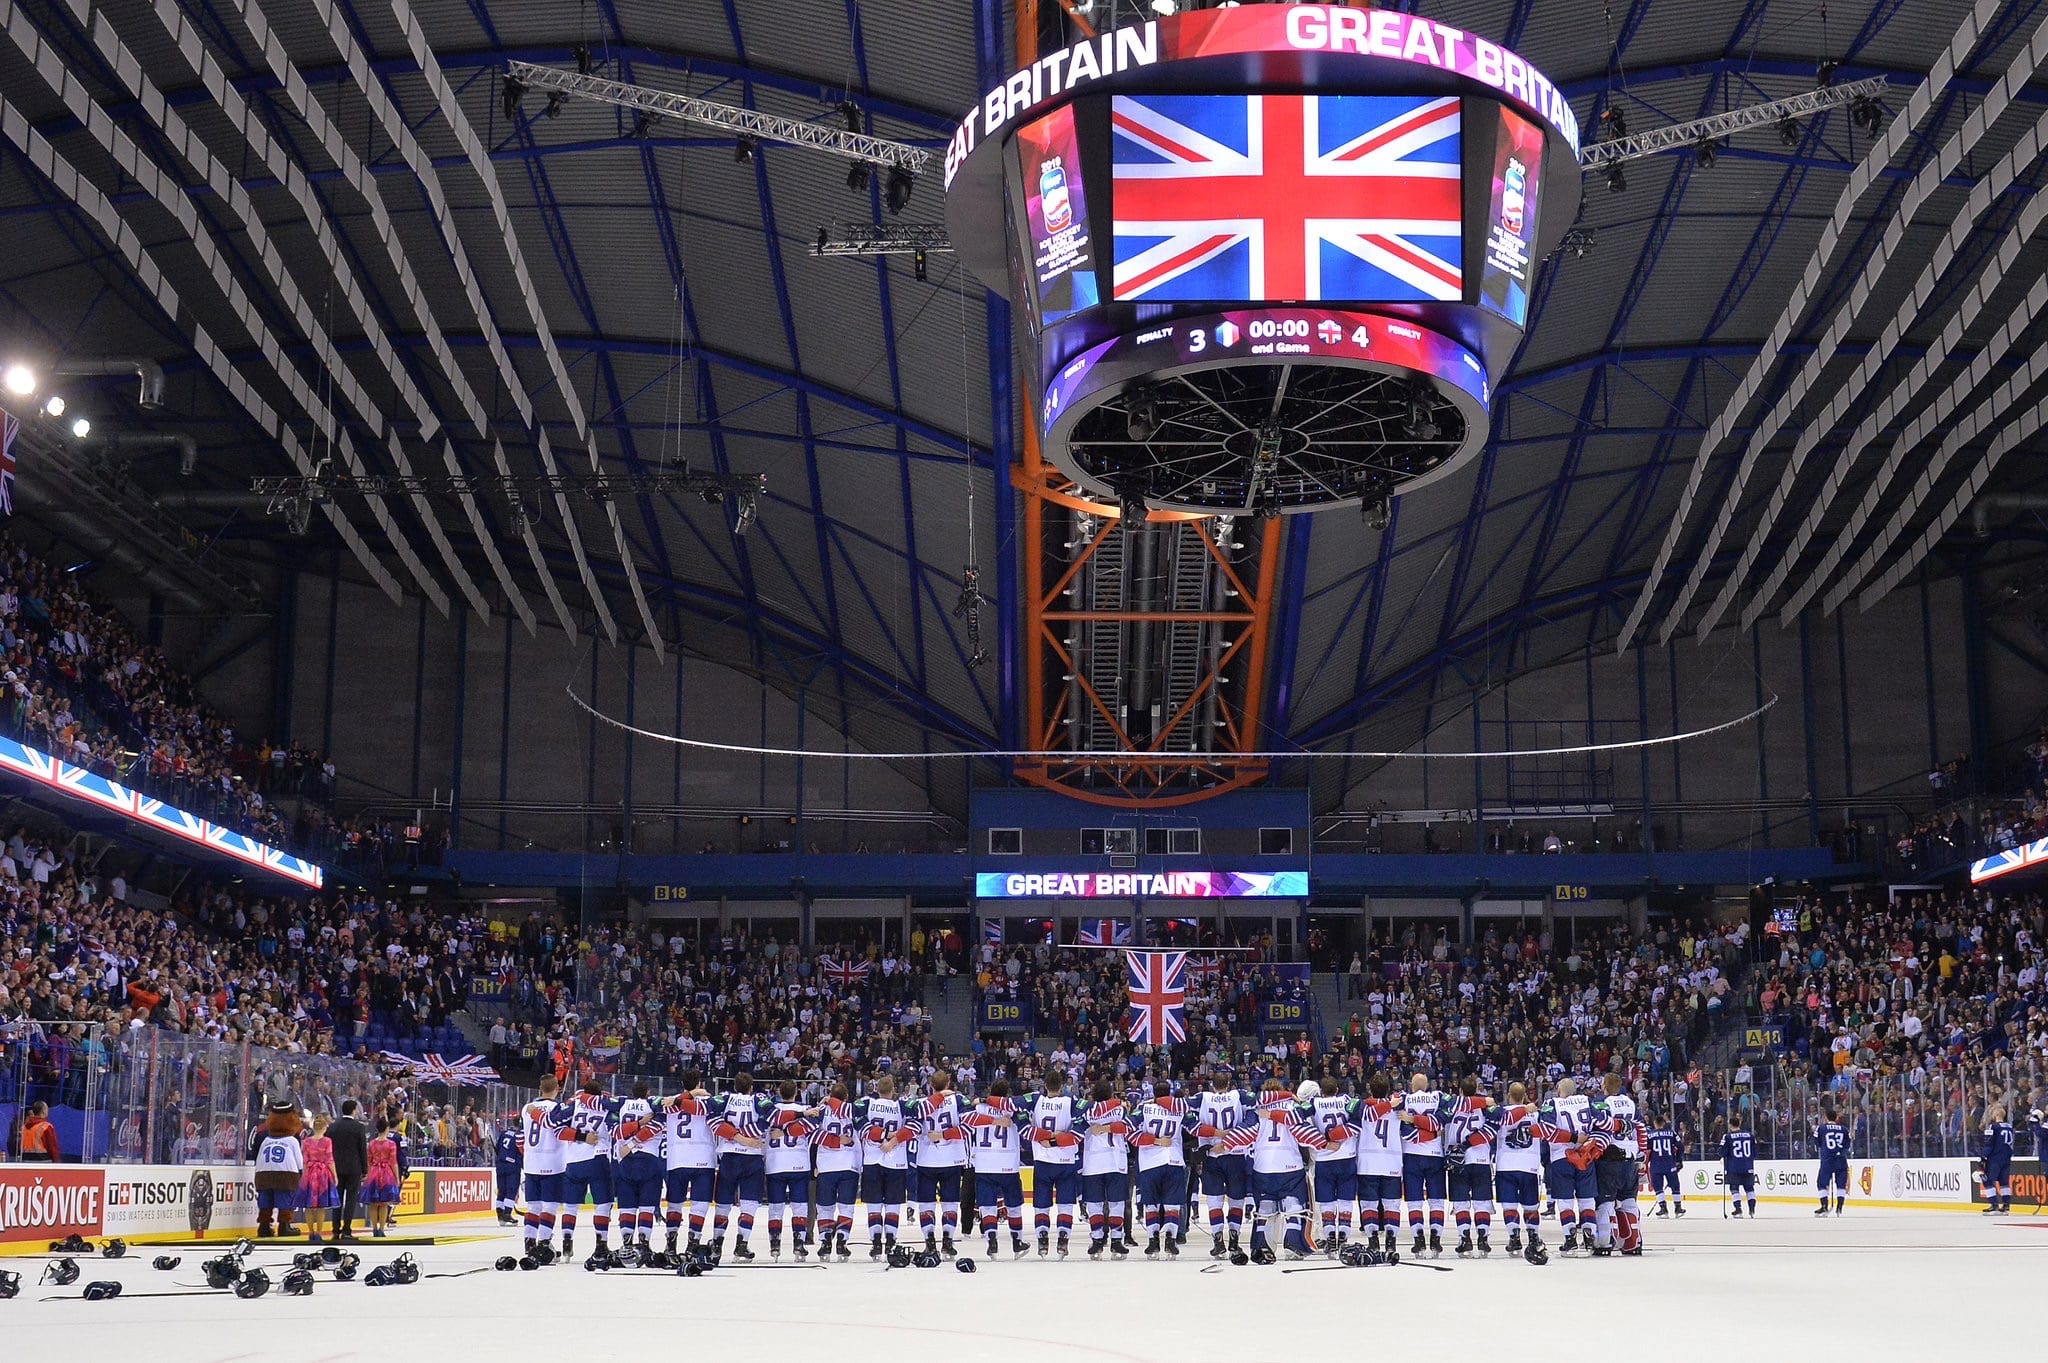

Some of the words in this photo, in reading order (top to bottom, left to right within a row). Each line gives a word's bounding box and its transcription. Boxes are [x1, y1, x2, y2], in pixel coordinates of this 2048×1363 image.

[985, 20, 1157, 136] BRITAIN
[1286, 6, 1463, 71] GREAT
[1476, 38, 1579, 161] BRITAIN
[1136, 327, 1174, 345] PENALTY
[1250, 320, 1309, 338] 00:00
[1352, 326, 1369, 347] 4
[1388, 325, 1421, 340] PENALTY
[1189, 329, 1206, 352] 3
[1276, 342, 1310, 353] Game
[656, 887, 667, 899] B
[672, 887, 687, 898] 18
[1007, 874, 1090, 895] GREAT
[1095, 874, 1197, 895] BRITAIN
[1557, 886, 1569, 899] A
[1573, 886, 1587, 898] 19
[989, 1005, 1001, 1018] B
[1003, 1006, 1019, 1018] 19
[1271, 1005, 1283, 1018] B
[1285, 1006, 1300, 1017] 19
[1748, 1031, 1760, 1046] A
[627, 1103, 644, 1111] LAKE
[574, 1112, 605, 1134] 27
[677, 1112, 692, 1139] 2
[1209, 1106, 1234, 1130] 10
[529, 1116, 540, 1147] 8
[980, 1126, 1007, 1148] 14
[1375, 1119, 1388, 1148] 4
[263, 1146, 286, 1164] 19
[1653, 1140, 1672, 1156] 44
[1733, 1141, 1750, 1157] 20
[1779, 1171, 1808, 1186] ŠKODA
[132, 1182, 187, 1205] TISSOT
[1995, 1174, 2048, 1204] rang
[107, 1211, 126, 1221] SWISS
[128, 1210, 155, 1220] WATCHES
[157, 1209, 173, 1219] SINCE
